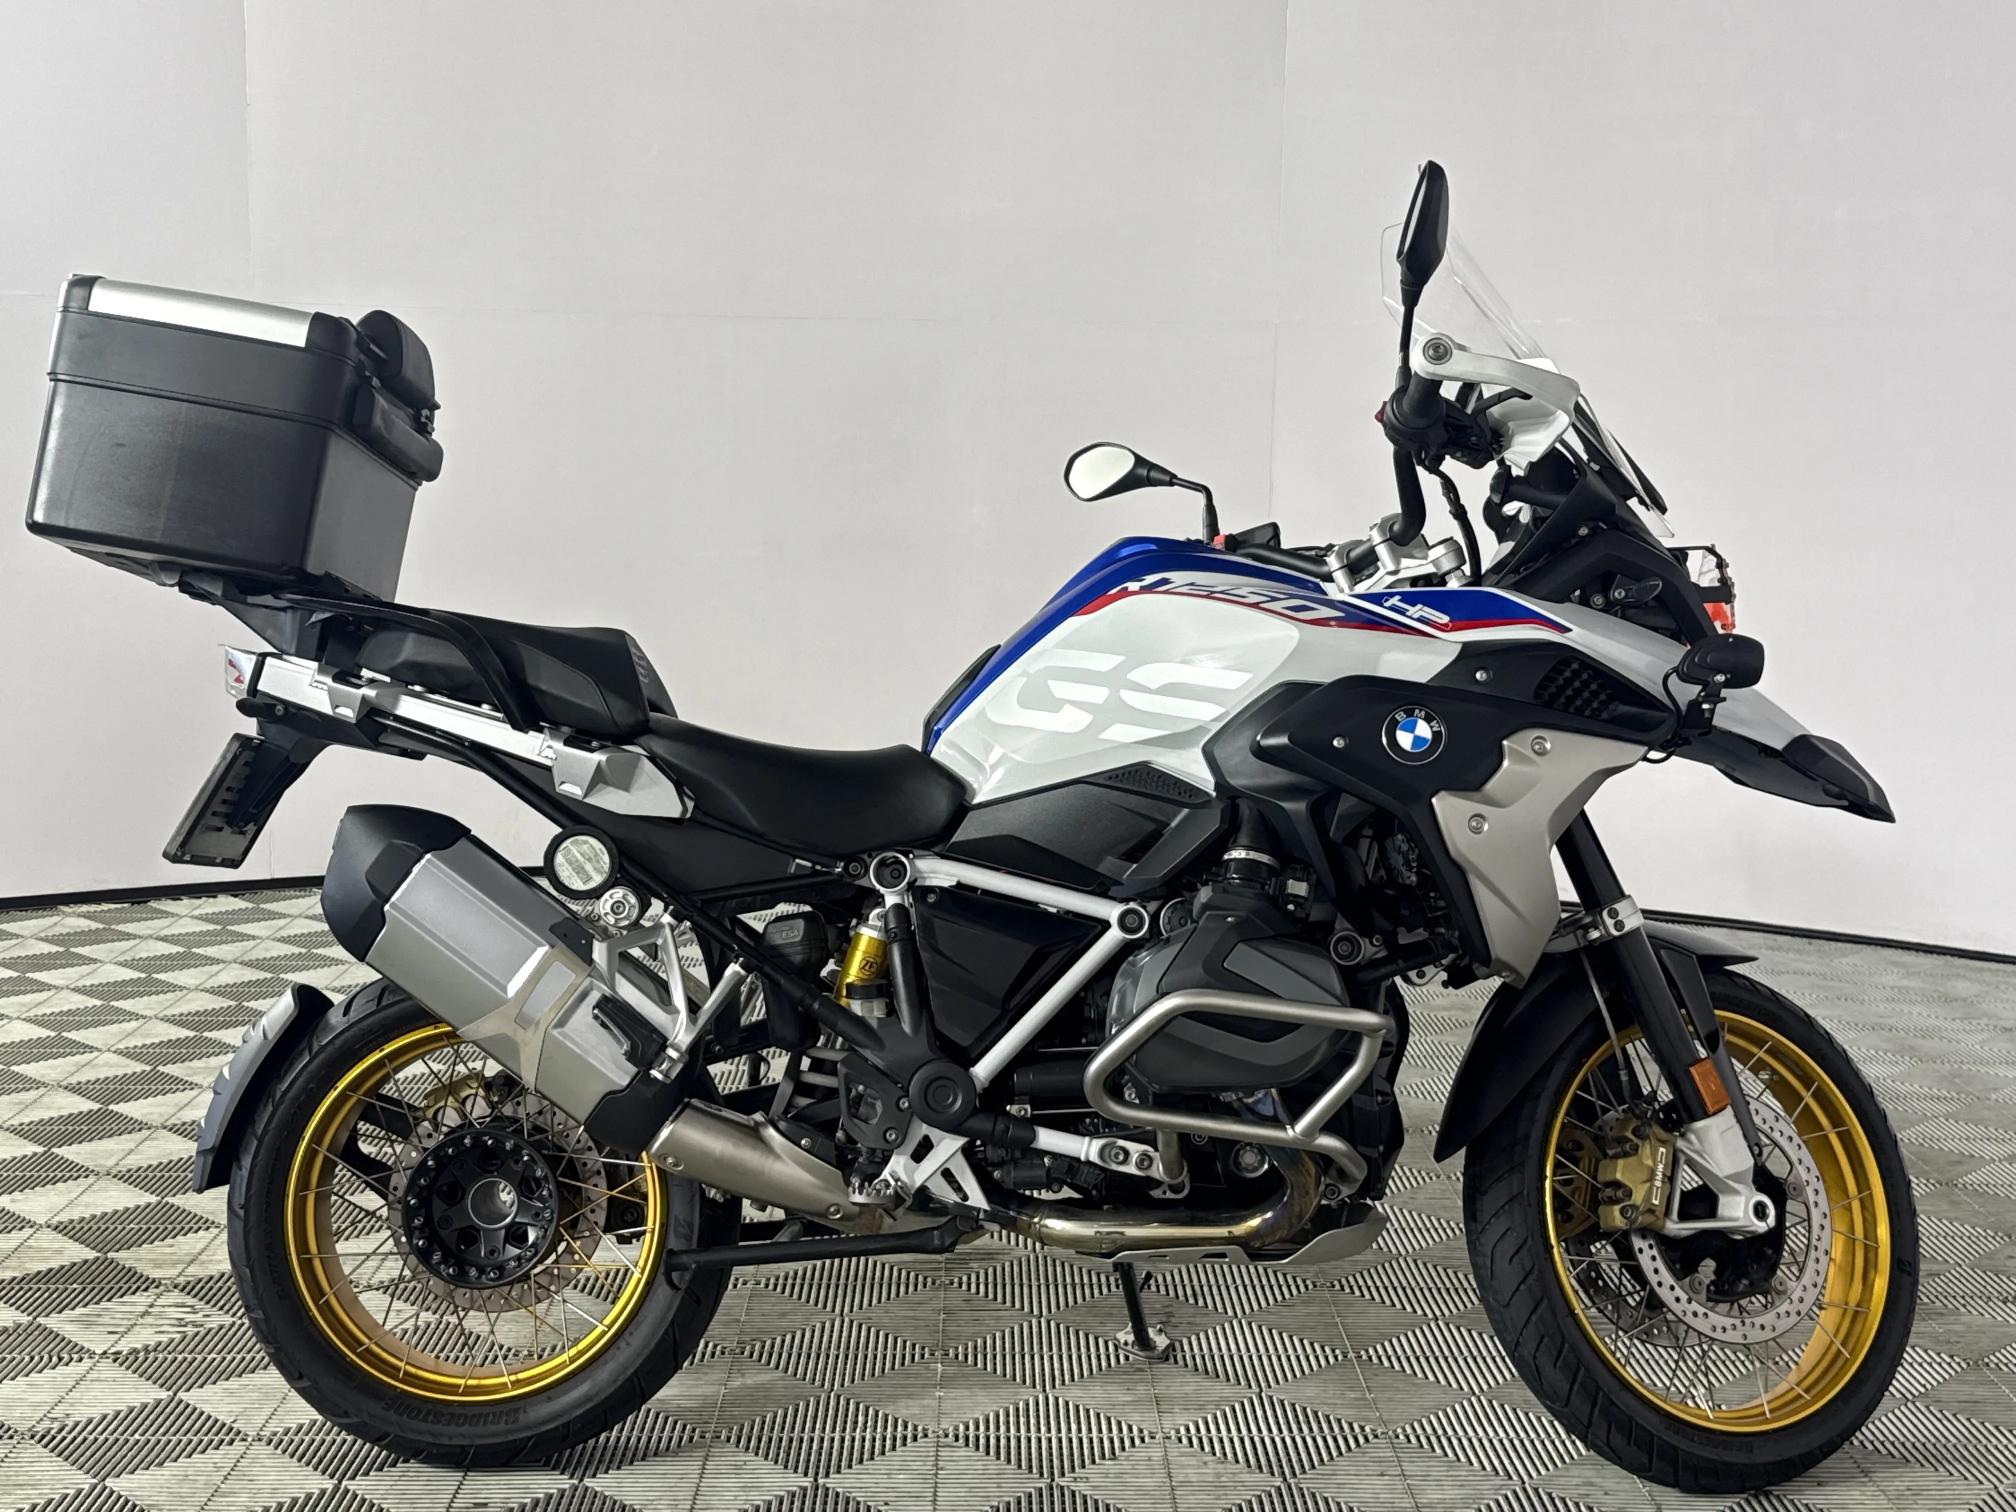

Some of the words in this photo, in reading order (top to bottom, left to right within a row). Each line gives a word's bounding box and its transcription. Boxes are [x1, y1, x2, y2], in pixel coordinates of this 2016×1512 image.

[1382, 595, 1451, 625] HP
[985, 648, 1254, 748] GS
[1395, 709, 1441, 731] BMW
[1654, 1163, 1665, 1187] BMW
